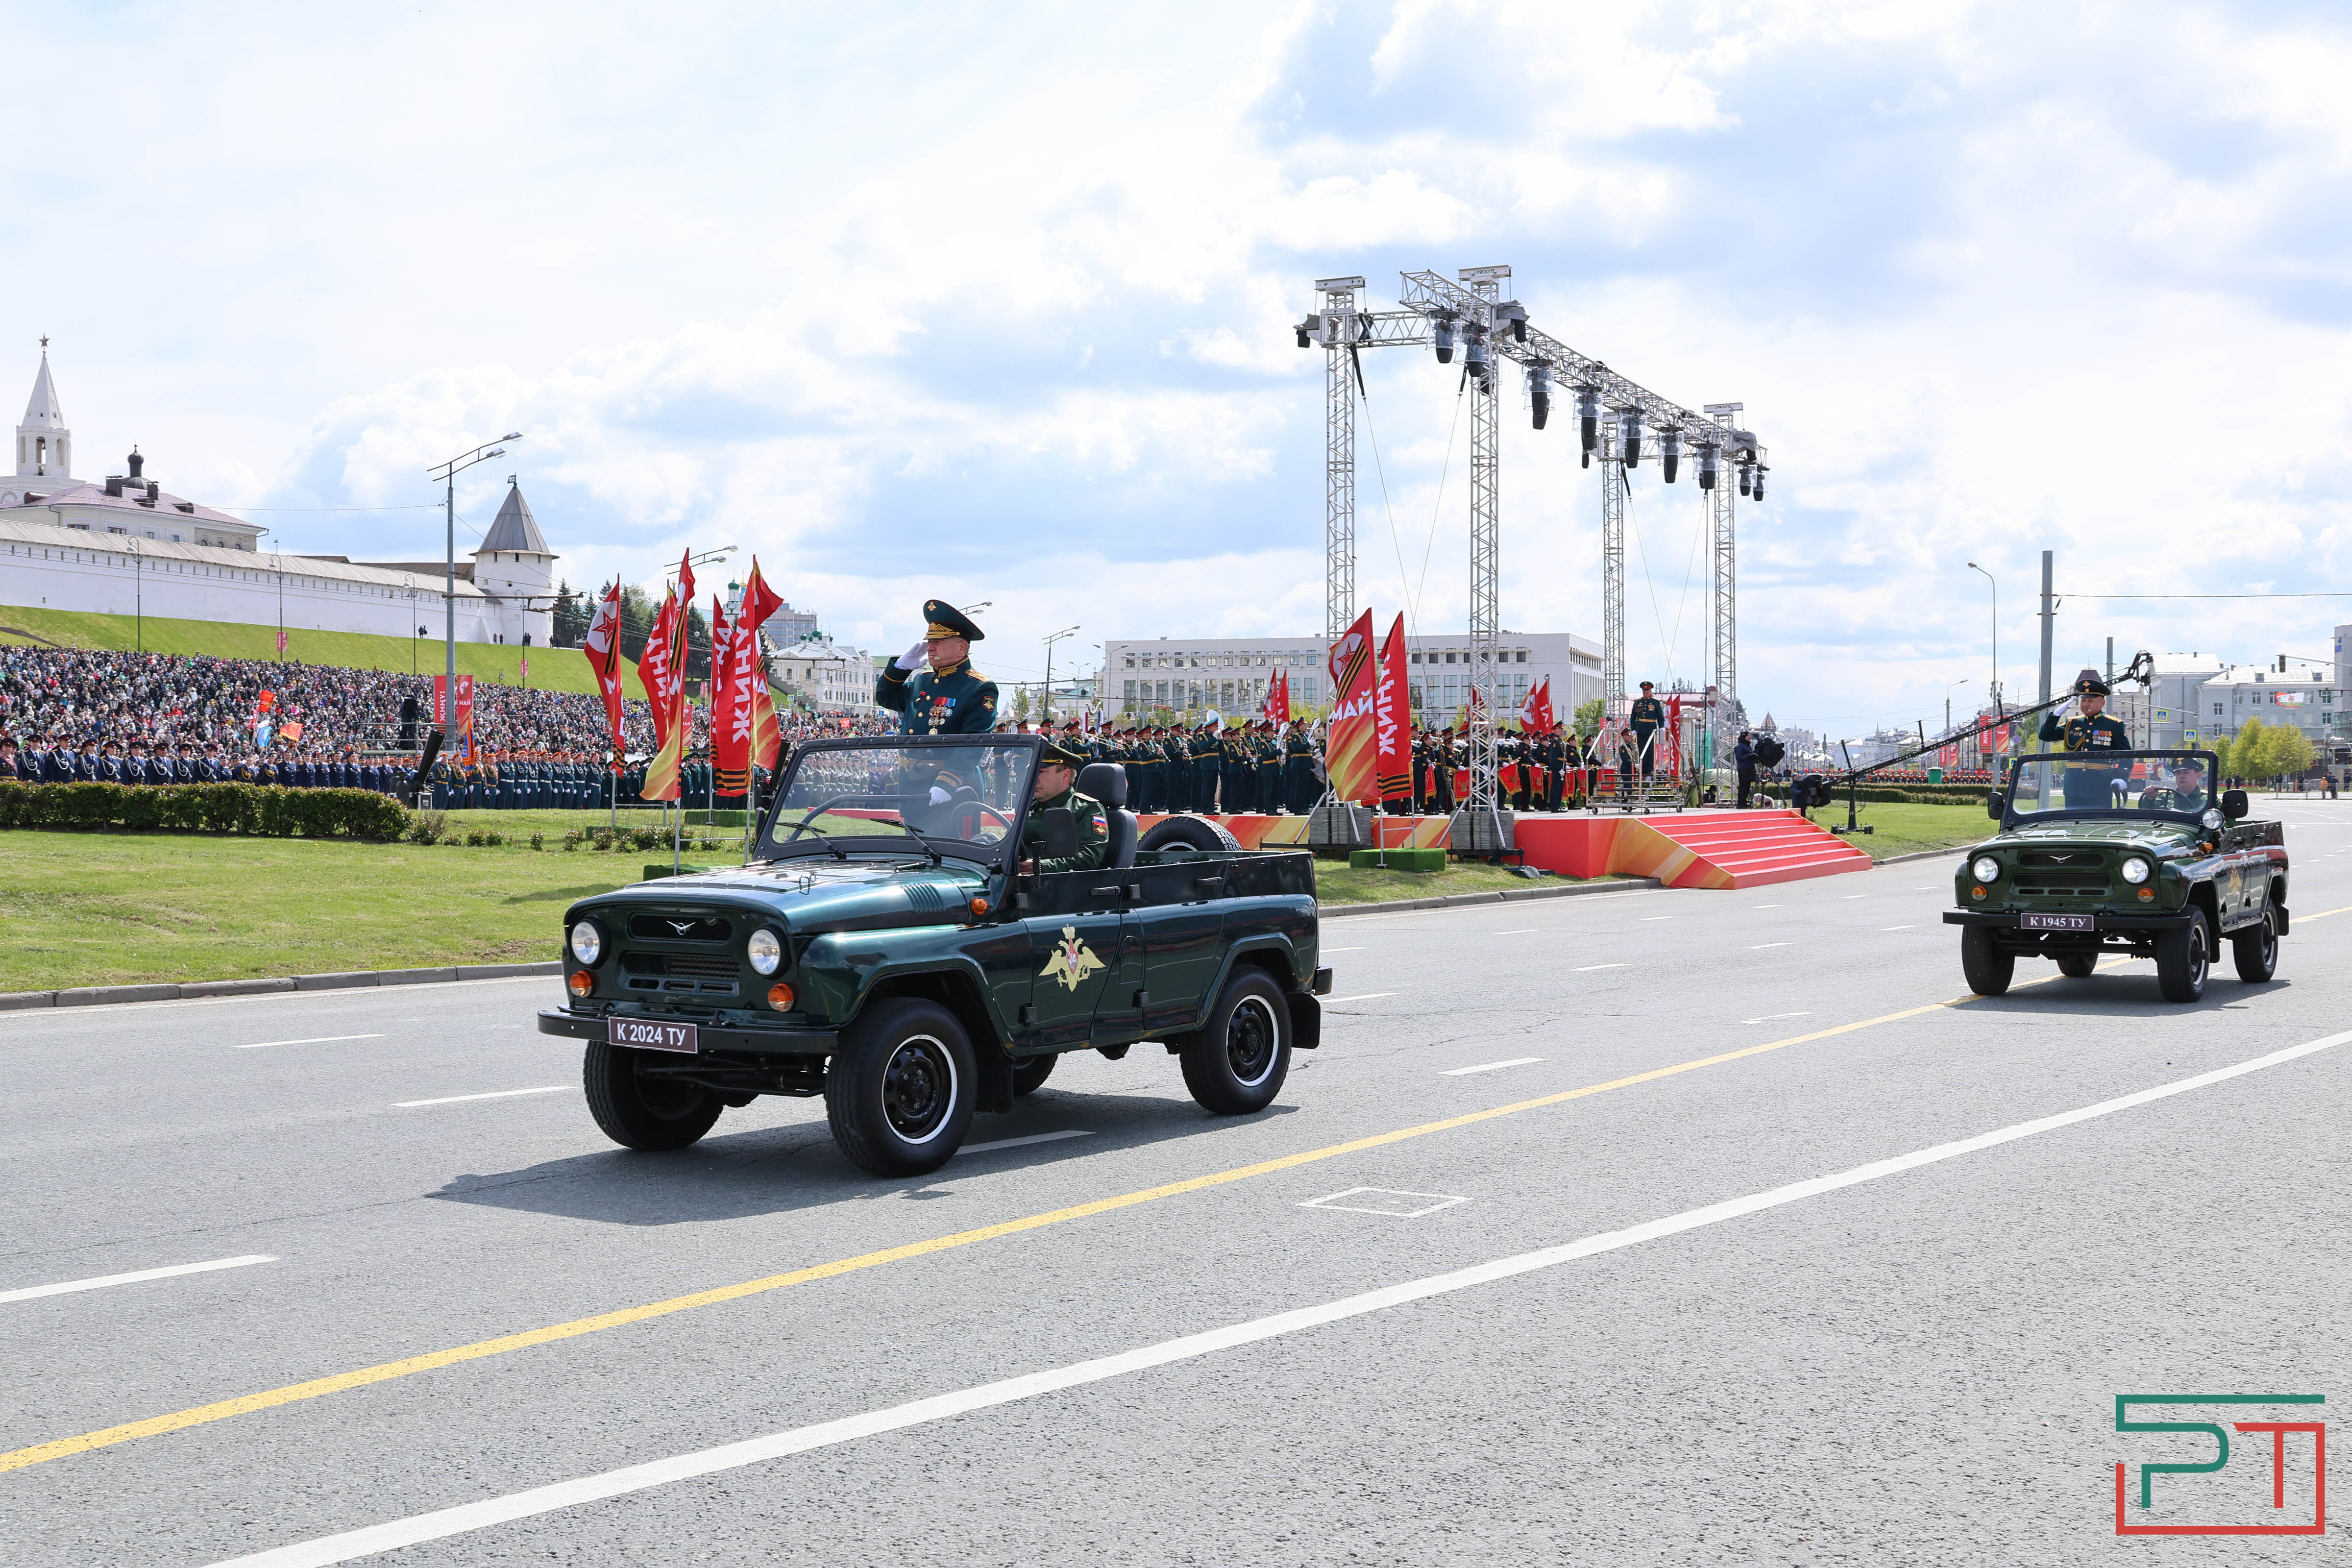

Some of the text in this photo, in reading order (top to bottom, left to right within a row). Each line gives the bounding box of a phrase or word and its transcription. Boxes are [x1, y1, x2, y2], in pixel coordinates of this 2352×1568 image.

[1332, 690, 1374, 724] МАЙ
[2030, 917, 2086, 928] К 1945 ТУ
[616, 1023, 686, 1046] К 2024 ТУ
